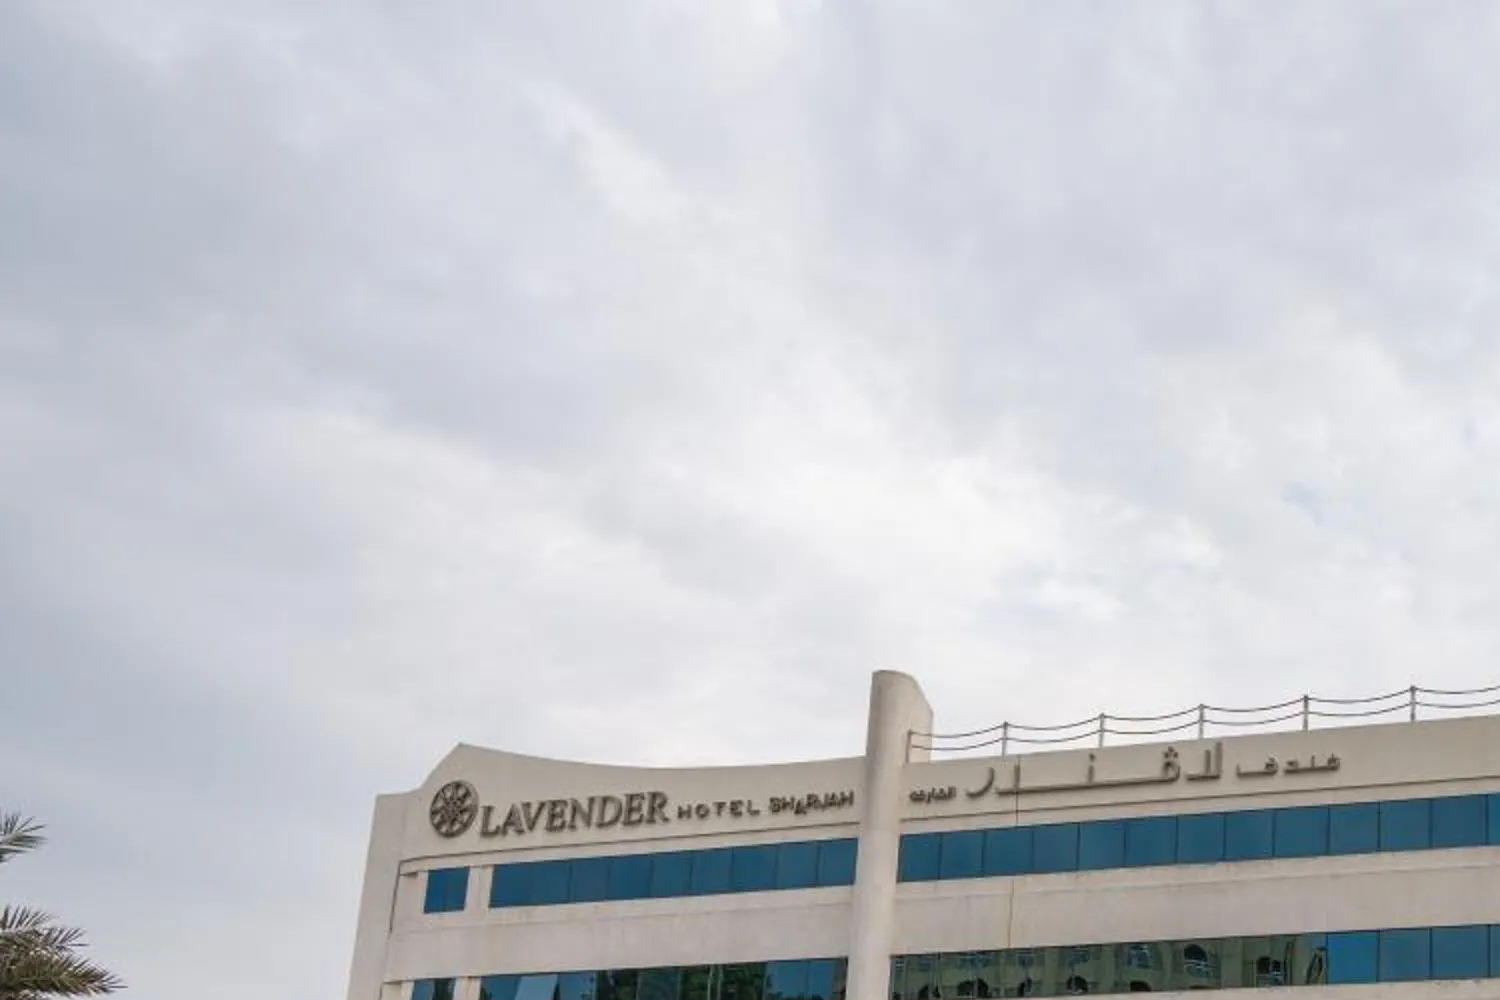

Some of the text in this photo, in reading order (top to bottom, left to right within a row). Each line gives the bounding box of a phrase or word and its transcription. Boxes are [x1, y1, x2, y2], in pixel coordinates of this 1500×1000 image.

[480, 789, 855, 838] LAVENDER HOTEL SHARJAH
